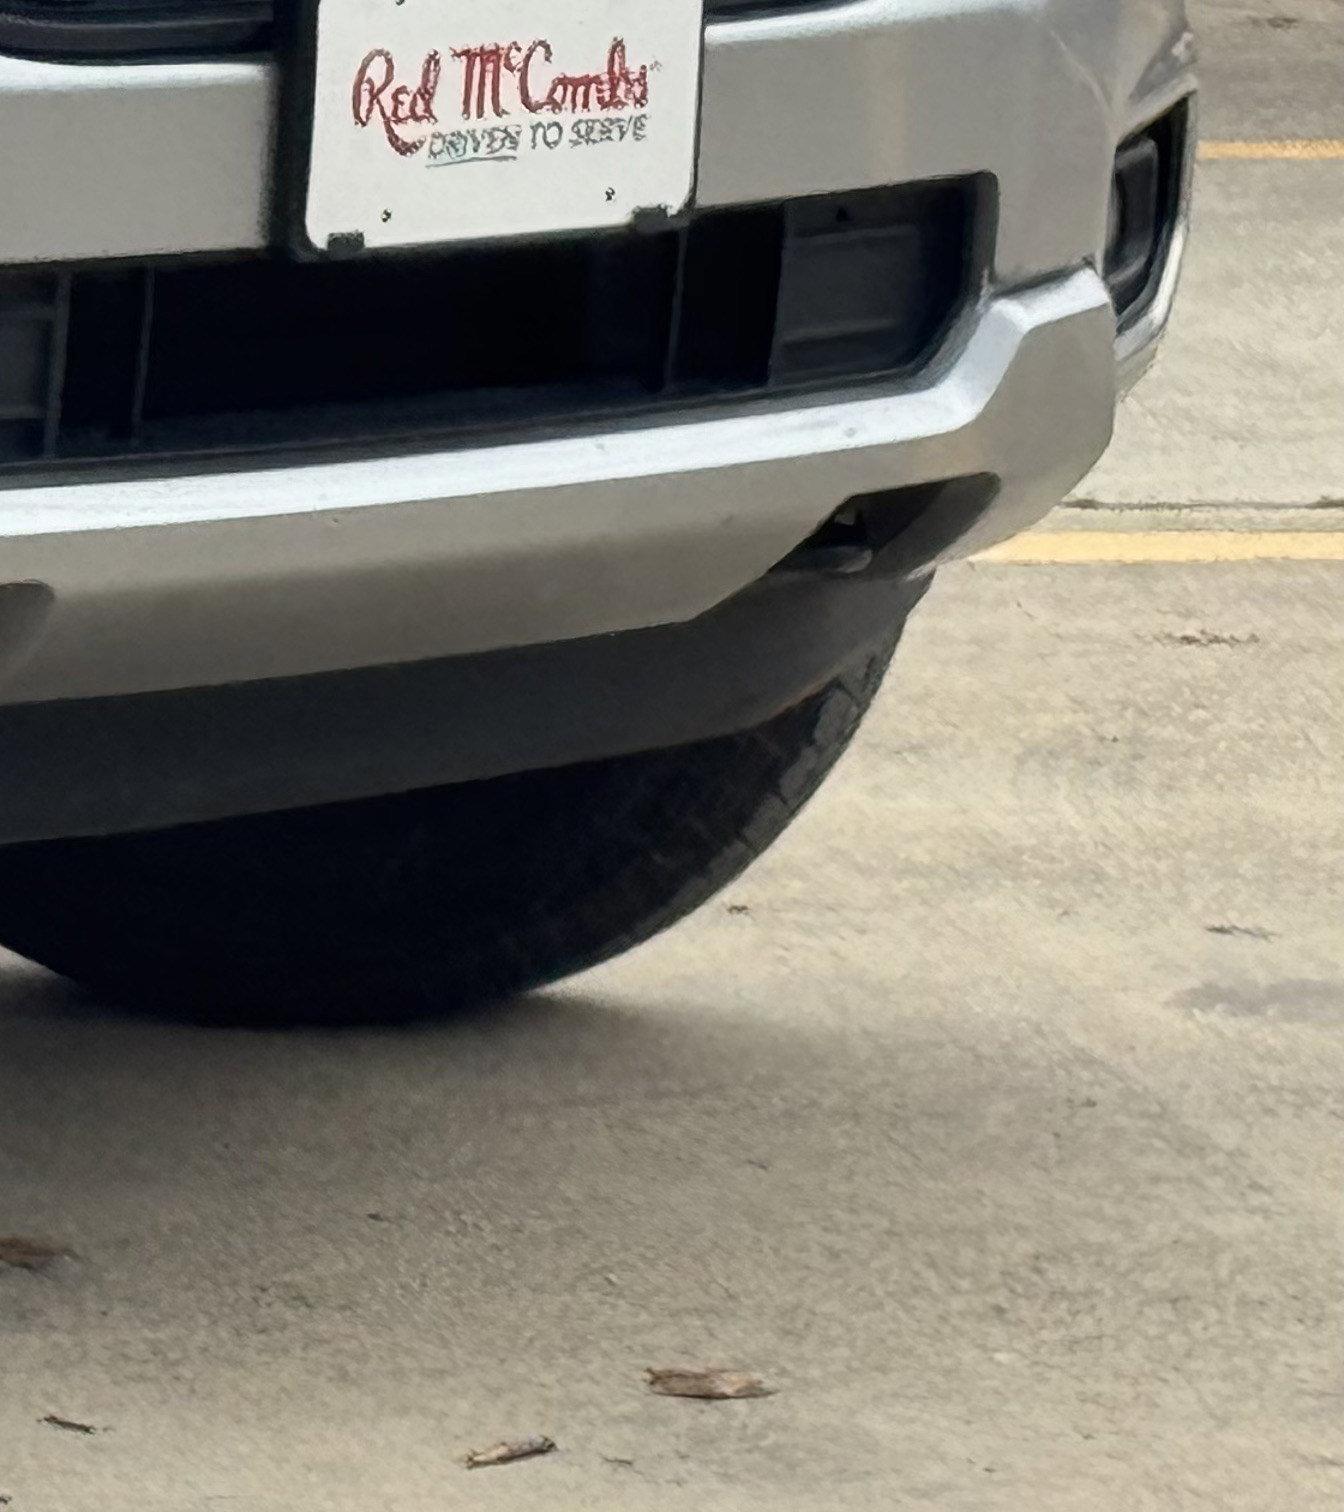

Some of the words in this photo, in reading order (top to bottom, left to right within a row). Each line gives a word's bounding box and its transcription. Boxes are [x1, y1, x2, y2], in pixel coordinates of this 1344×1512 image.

[352, 48, 441, 158] Red
[450, 36, 649, 120] McCombs
[531, 120, 563, 150] TO
